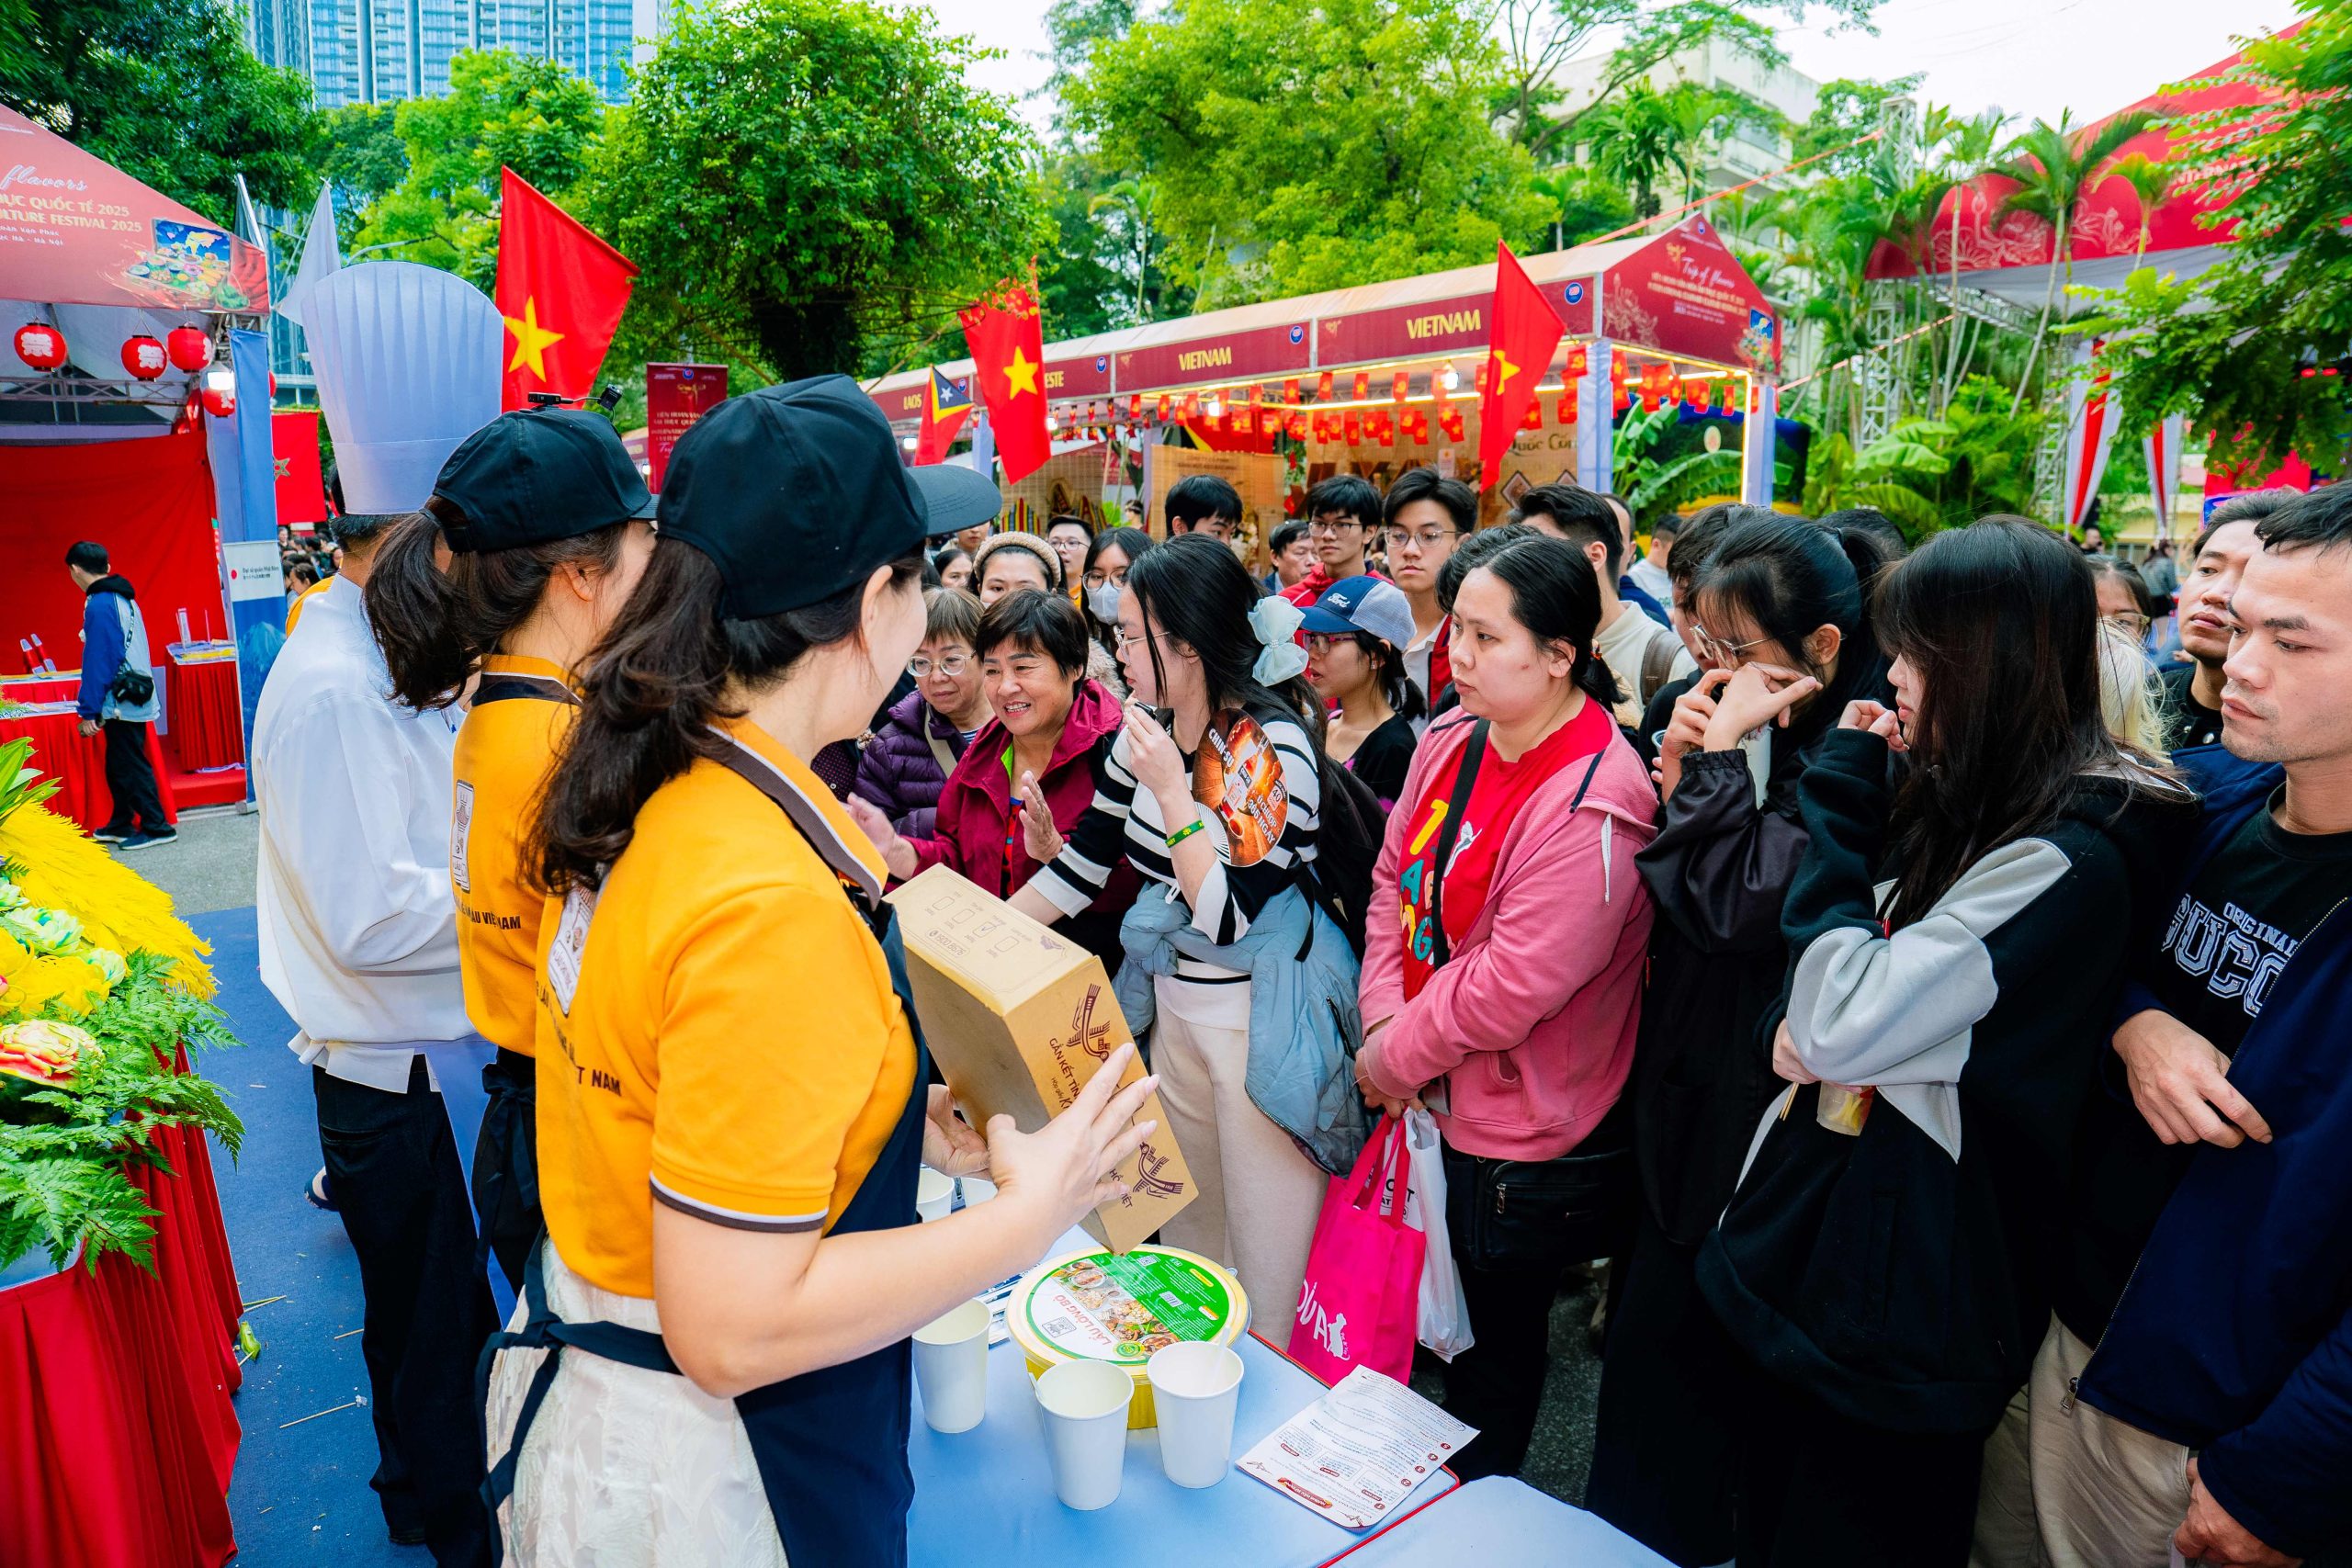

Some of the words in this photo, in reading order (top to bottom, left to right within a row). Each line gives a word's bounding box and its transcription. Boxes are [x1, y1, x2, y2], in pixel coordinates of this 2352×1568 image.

[50, 213, 107, 230] FESTIVAL
[111, 220, 143, 232] 2025
[97, 204, 130, 218] 2025
[1406, 309, 1481, 339] VIETNAM
[1178, 345, 1232, 371] VIETNAM
[903, 394, 922, 411] LAOS
[1328, 593, 1351, 607] Ford
[1208, 728, 1235, 768] CHIN-SU
[2223, 901, 2299, 957] ORIGINAL
[591, 1068, 622, 1097] NAM
[1058, 1059, 1075, 1079] KẾT
[1068, 1078, 1081, 1100] TÌN
[1053, 1294, 1074, 1307] BÒ
[1067, 1305, 1093, 1328] LÒNG
